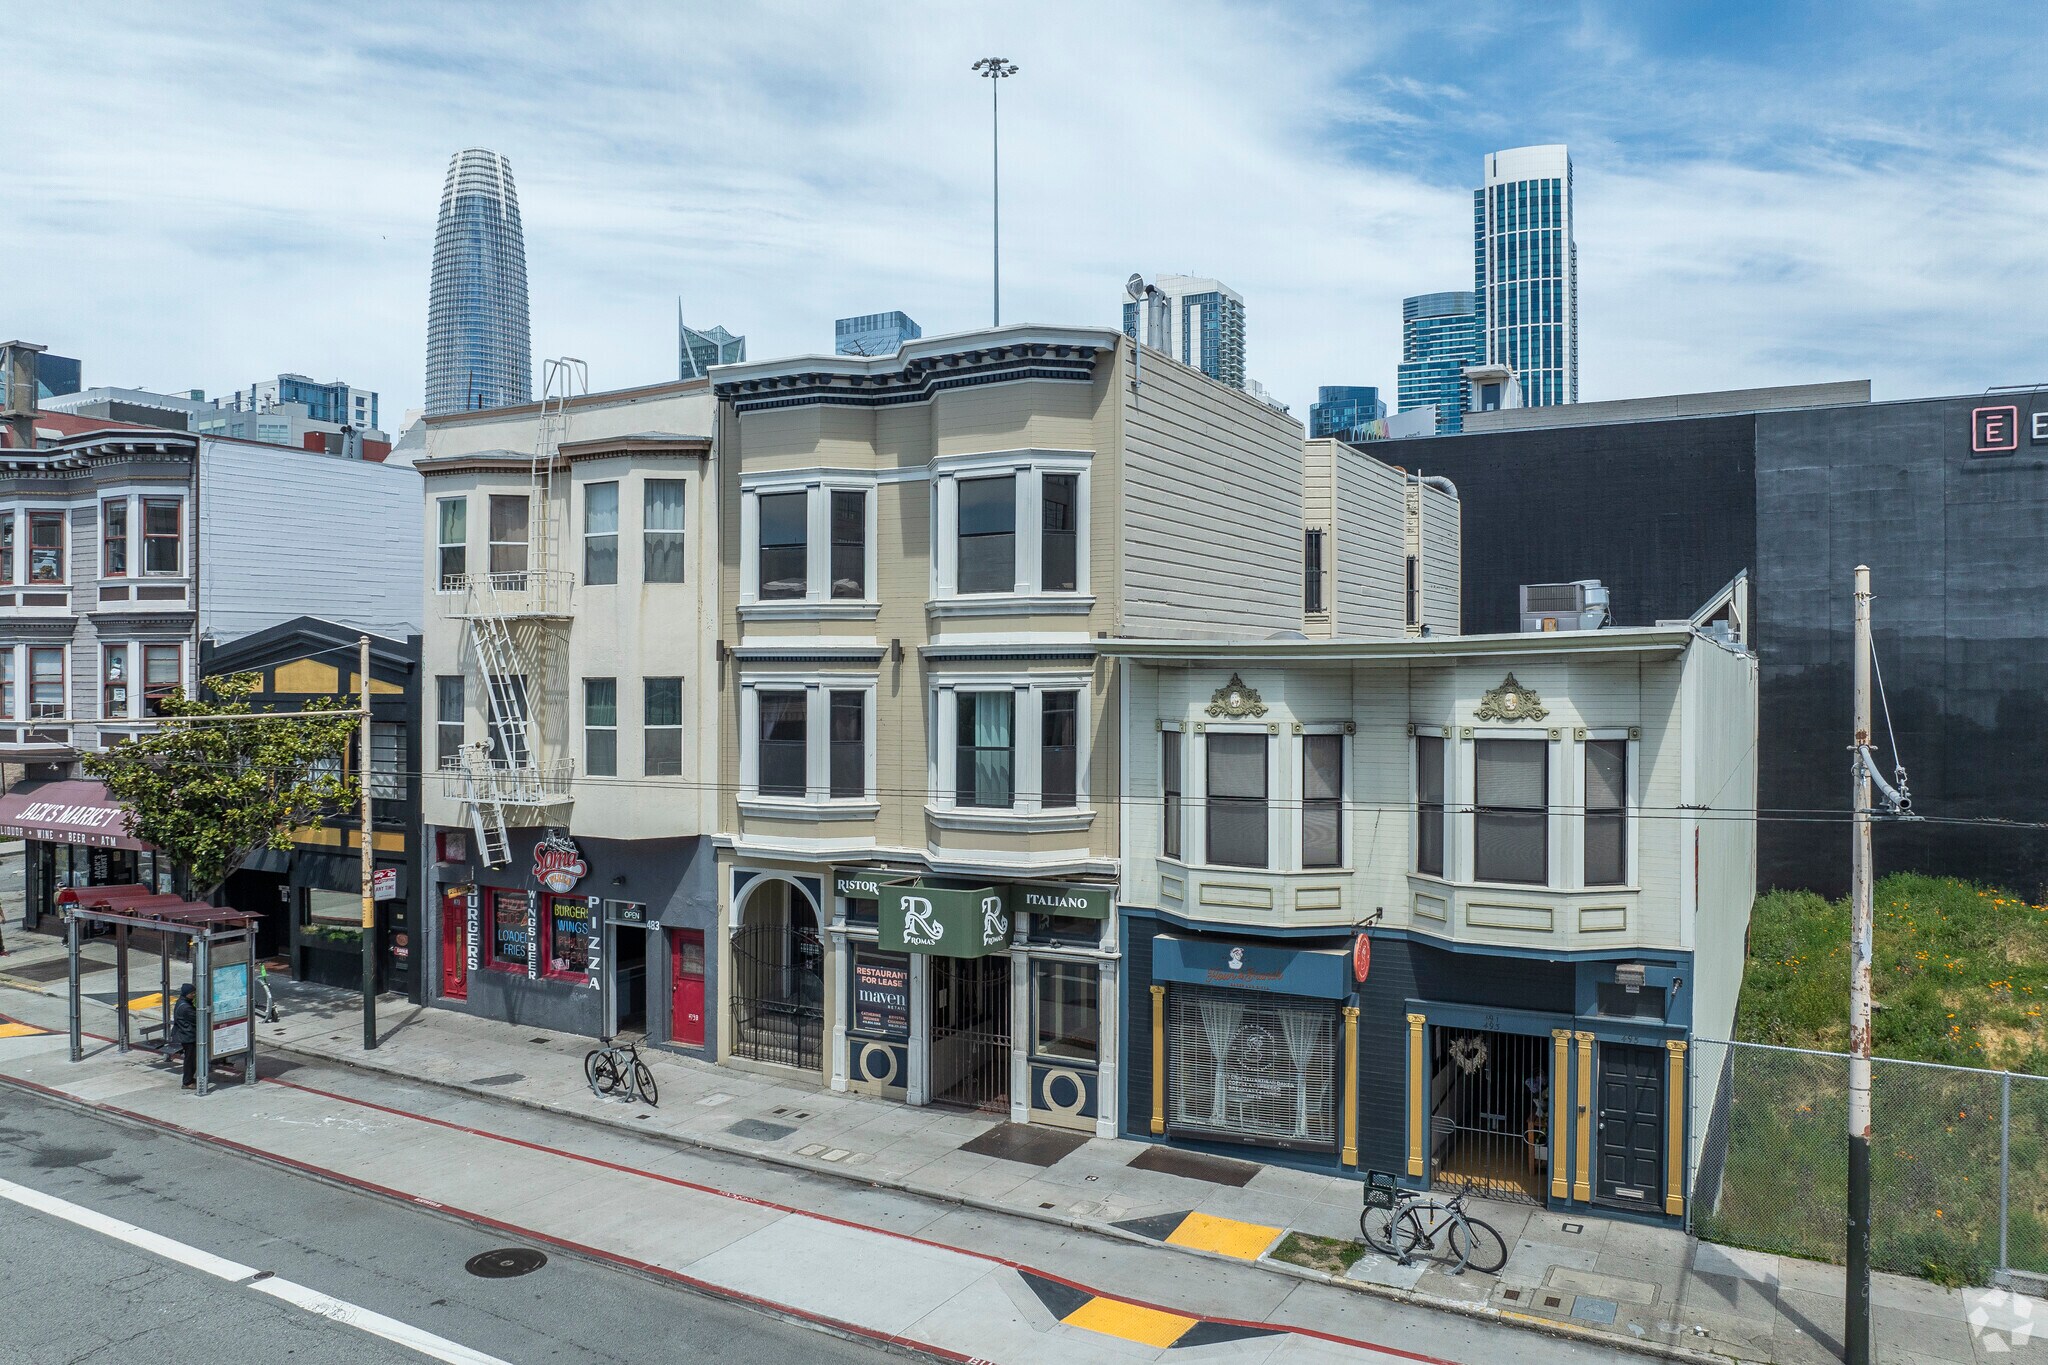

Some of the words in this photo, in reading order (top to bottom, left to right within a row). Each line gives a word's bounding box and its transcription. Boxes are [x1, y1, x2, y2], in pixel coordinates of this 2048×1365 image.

[15, 802, 65, 822] JACK'S
[55, 805, 121, 828] MARKET
[0, 826, 24, 836] LIQUOR
[37, 829, 54, 840] WINE
[68, 832, 86, 843] BEER
[100, 836, 117, 847] ATM
[532, 842, 584, 877] Soma
[837, 879, 880, 894] RISTOR
[1026, 893, 1088, 909] ITALIANO
[527, 889, 536, 936] WINGS
[624, 911, 640, 920] OPEN
[467, 884, 478, 971] BURGERS
[557, 919, 588, 934] WINGS
[646, 920, 660, 931] 483
[503, 943, 526, 957] FRIES
[588, 896, 600, 990] PIZZA
[528, 942, 537, 980] BEER
[856, 967, 908, 979] RESTAURANT
[861, 976, 877, 984] FOR
[878, 978, 903, 987] LEASE
[859, 989, 906, 1006] maven
